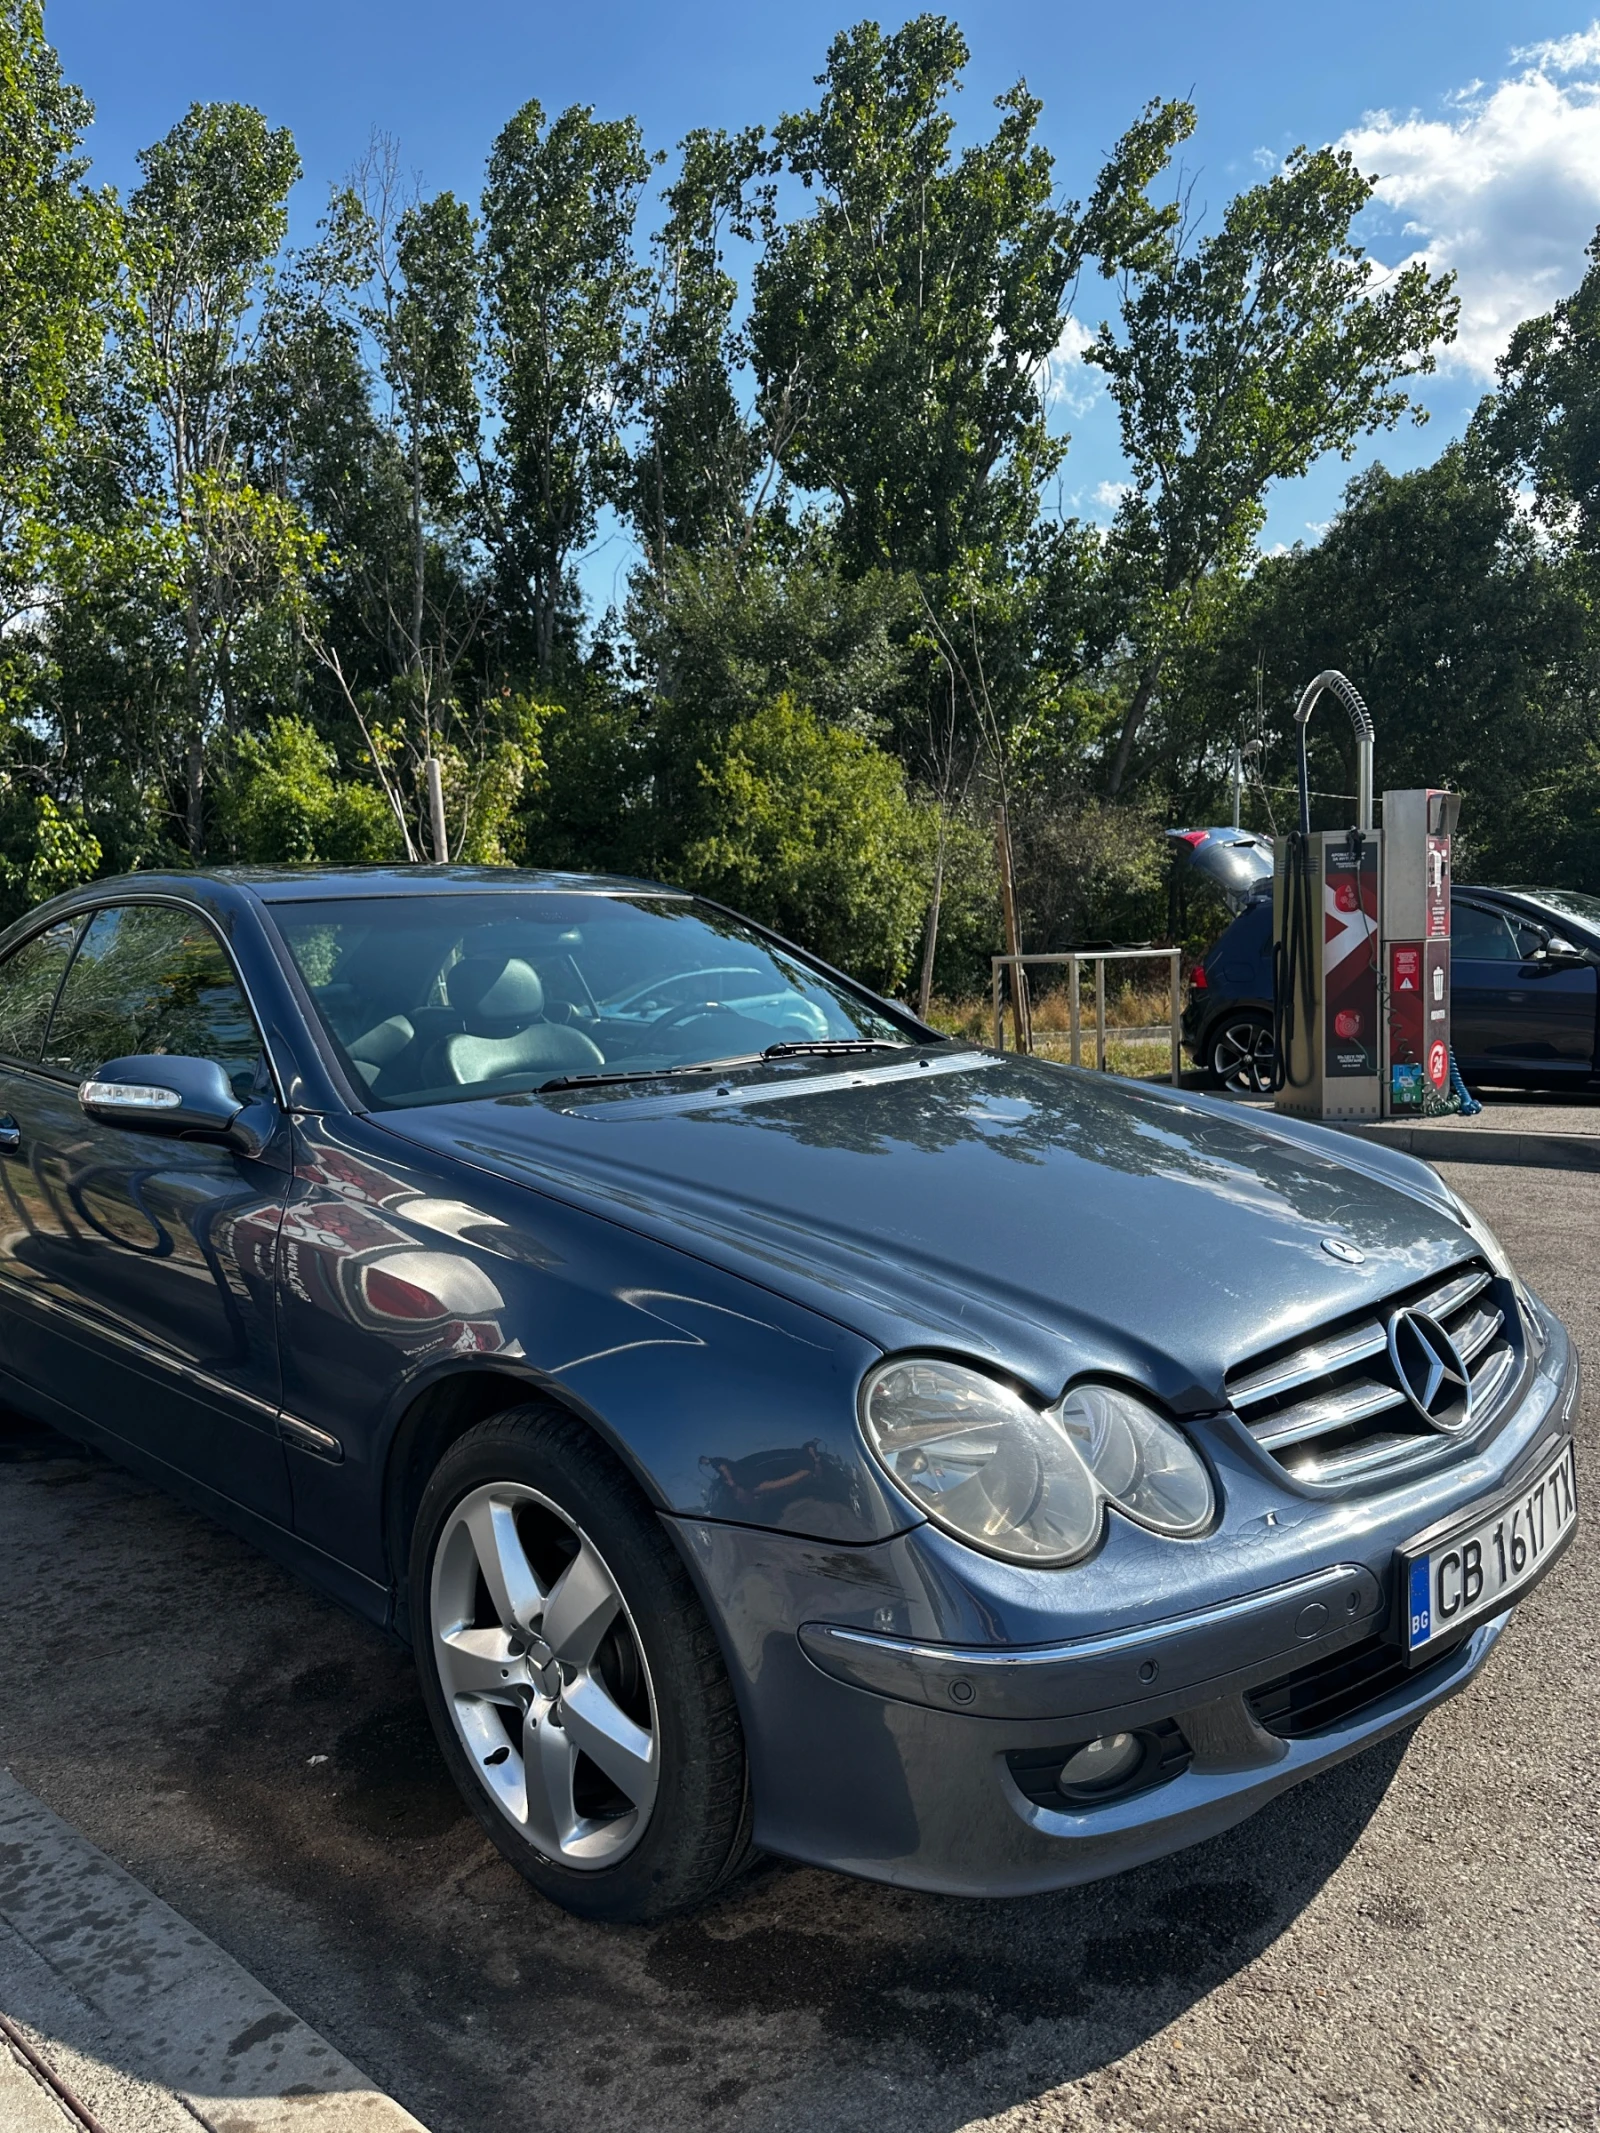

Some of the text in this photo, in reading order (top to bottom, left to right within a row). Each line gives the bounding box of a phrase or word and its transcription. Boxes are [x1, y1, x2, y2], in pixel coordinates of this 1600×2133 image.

[1433, 1055, 1443, 1073] 24
[1438, 1454, 1573, 1618] CB 1617 TX
[1411, 1611, 1429, 1634] BG
